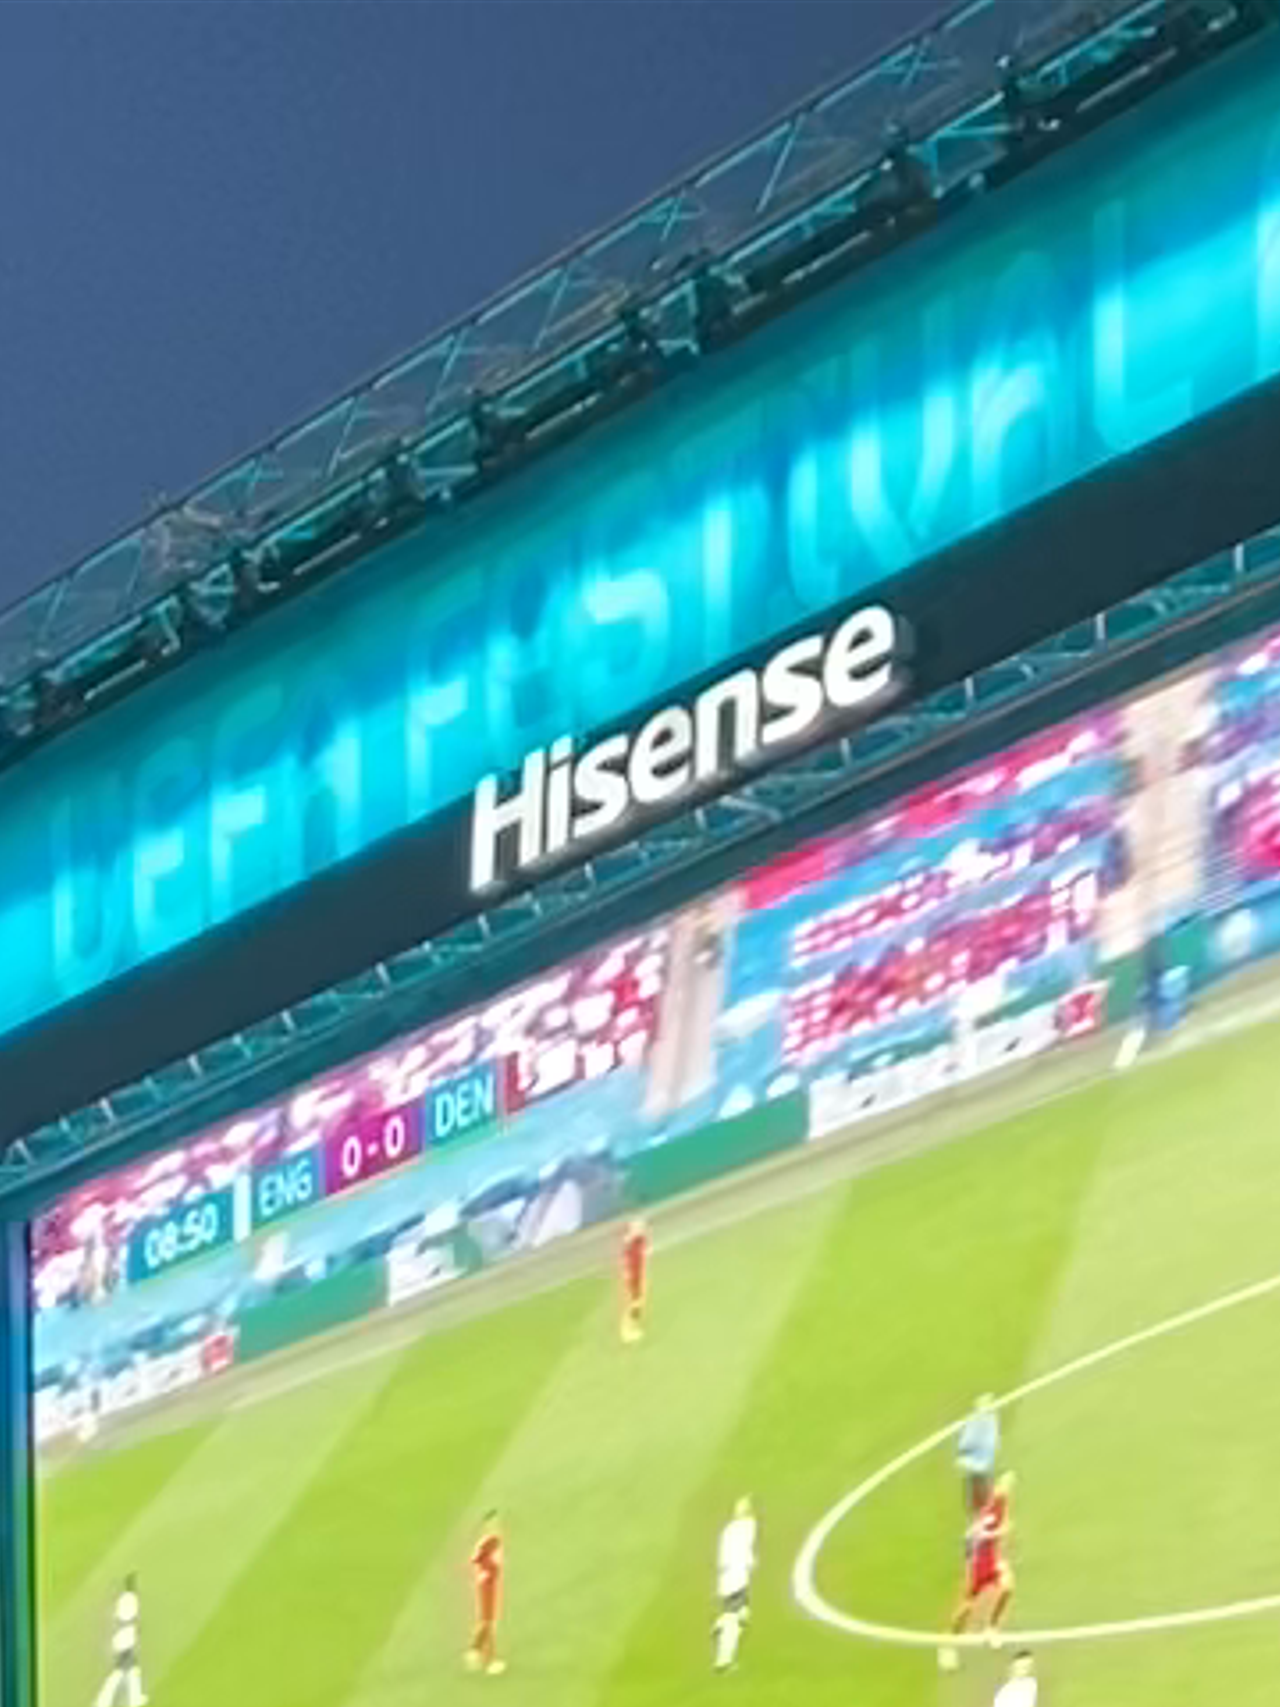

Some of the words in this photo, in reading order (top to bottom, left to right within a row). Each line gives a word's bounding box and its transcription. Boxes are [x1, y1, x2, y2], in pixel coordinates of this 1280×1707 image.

[468, 605, 897, 895] Hisense
[257, 1157, 313, 1217] ENG
[434, 1068, 495, 1138] DEN
